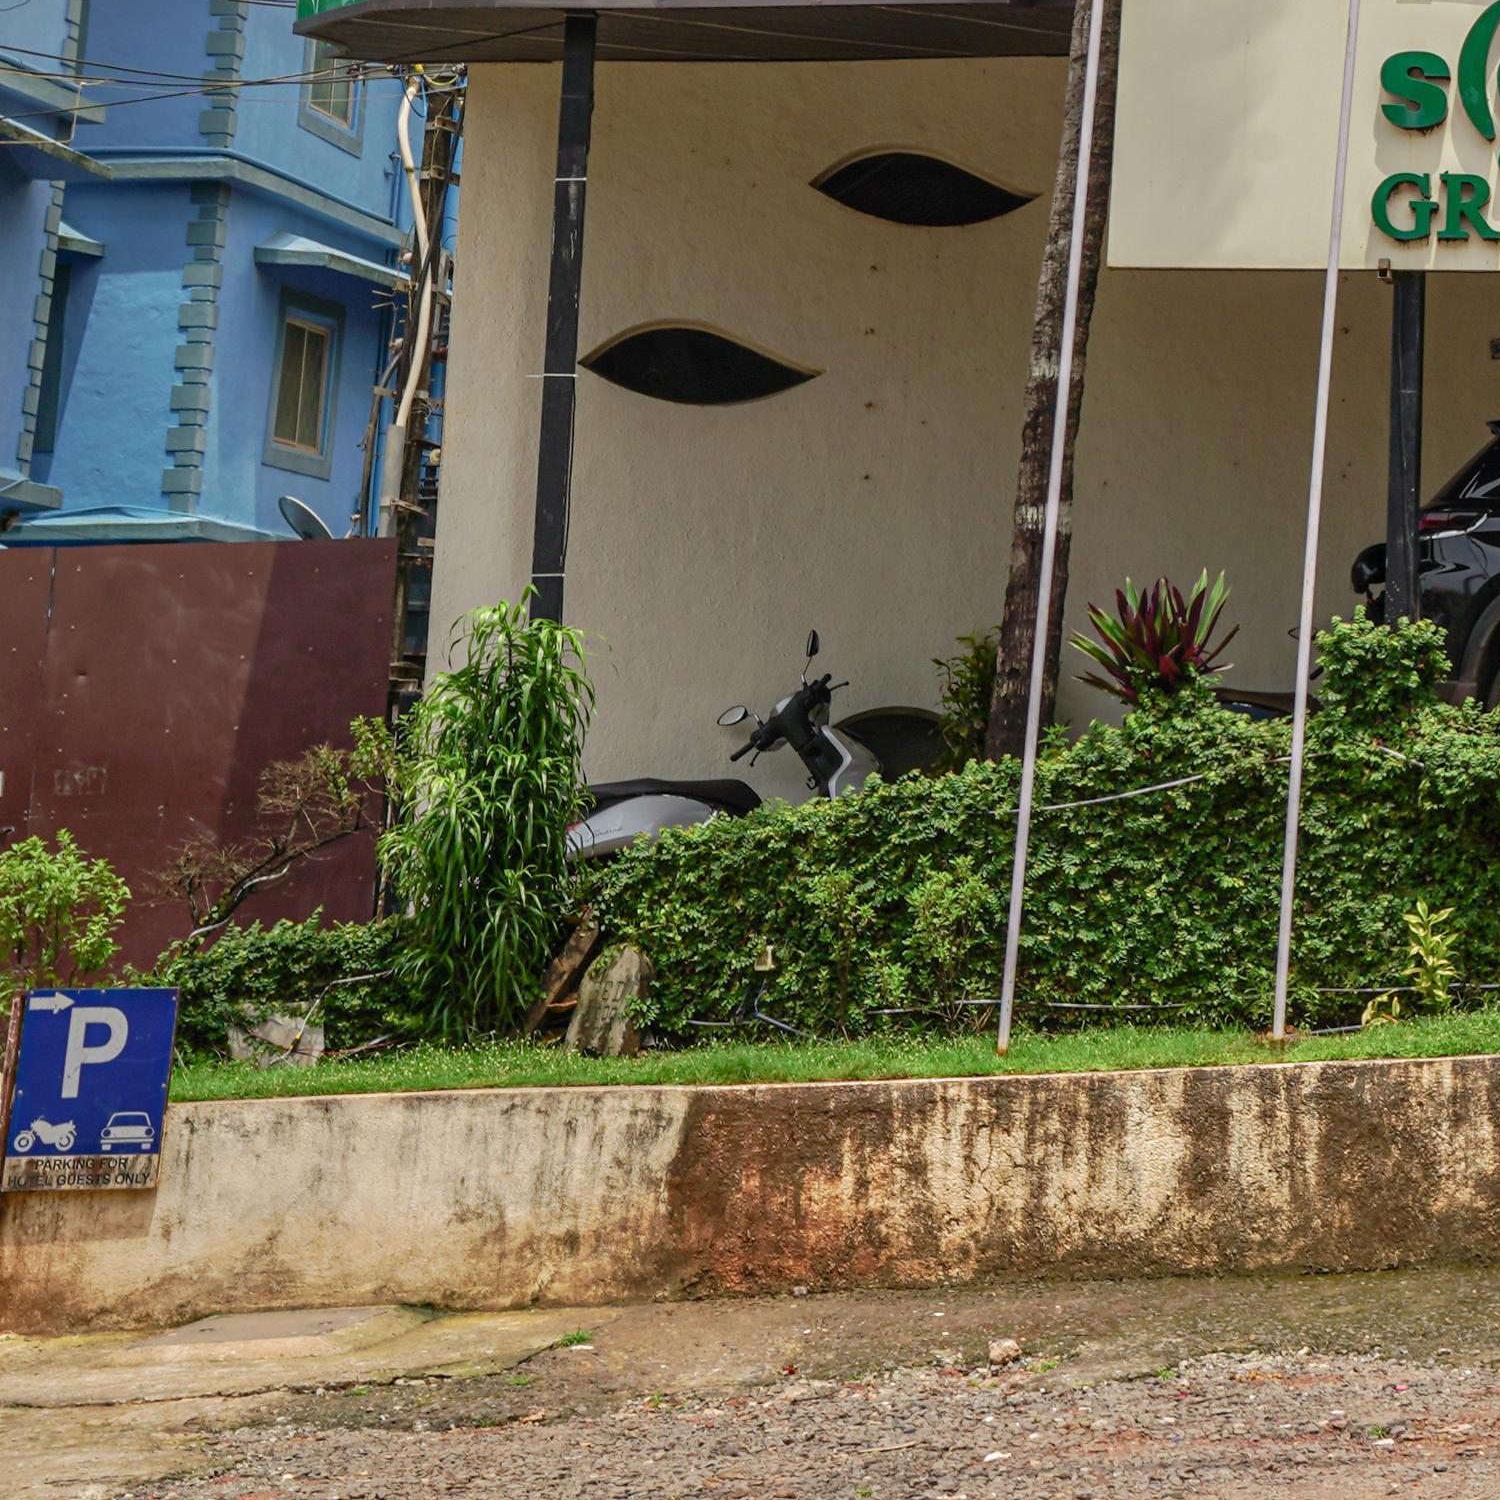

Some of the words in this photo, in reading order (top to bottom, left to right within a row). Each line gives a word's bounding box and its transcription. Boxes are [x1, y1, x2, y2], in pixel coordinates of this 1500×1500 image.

[61, 1006, 129, 1100] P
[35, 1158, 95, 1171] PARKING
[100, 1157, 128, 1170] FOR
[56, 1173, 111, 1186] GUESTS
[114, 1172, 151, 1186] ONLY
